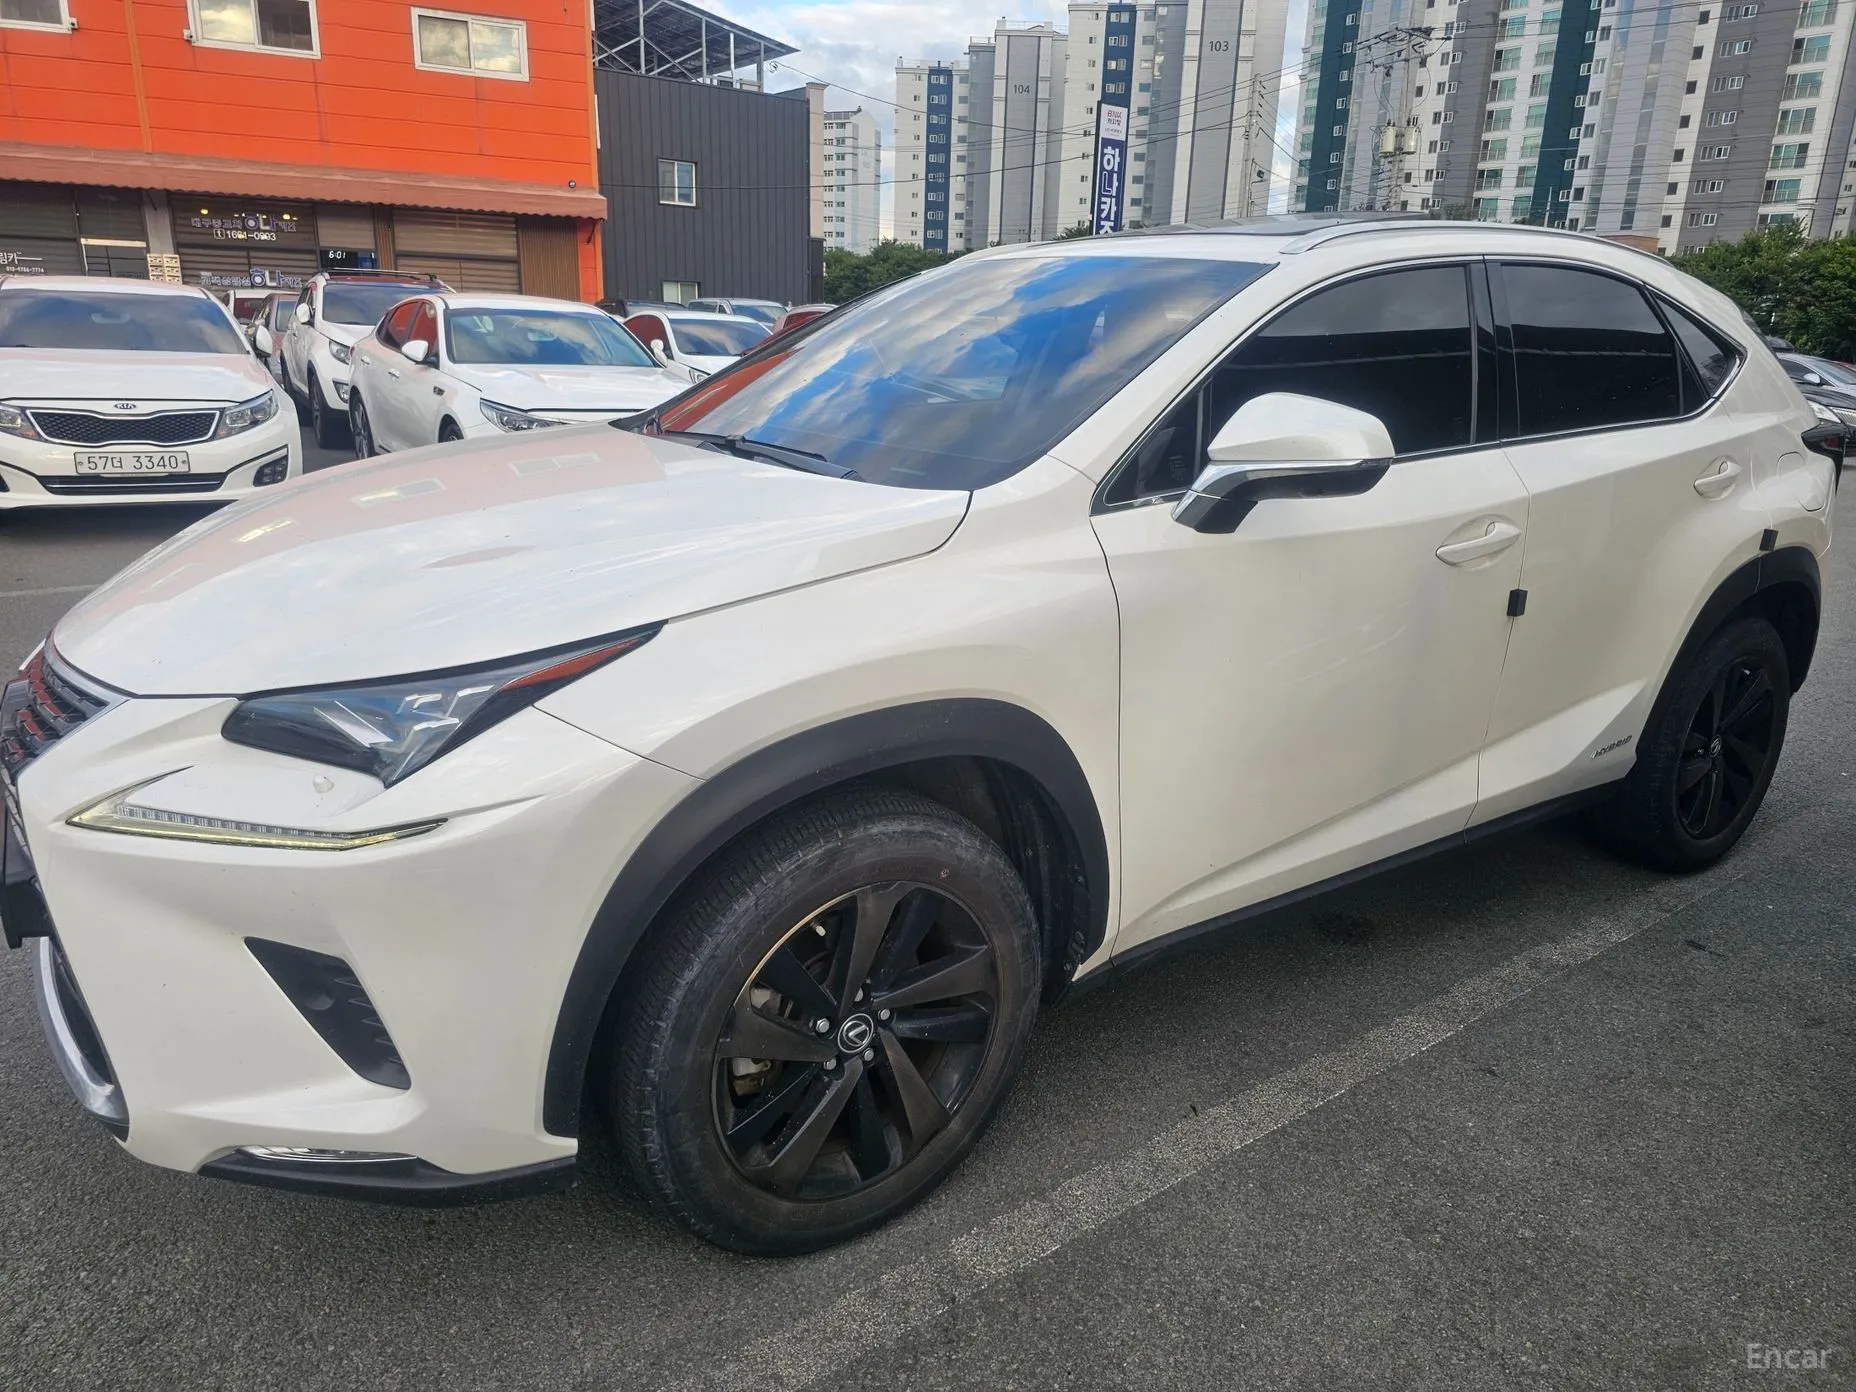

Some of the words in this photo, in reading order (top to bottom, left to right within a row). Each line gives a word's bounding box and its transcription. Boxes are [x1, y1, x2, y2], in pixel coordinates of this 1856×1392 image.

[1208, 40, 1229, 52] 103
[1013, 84, 1031, 95] 104
[116, 402, 135, 410] KIA
[87, 455, 123, 471] 57더
[132, 455, 179, 471] 3340
